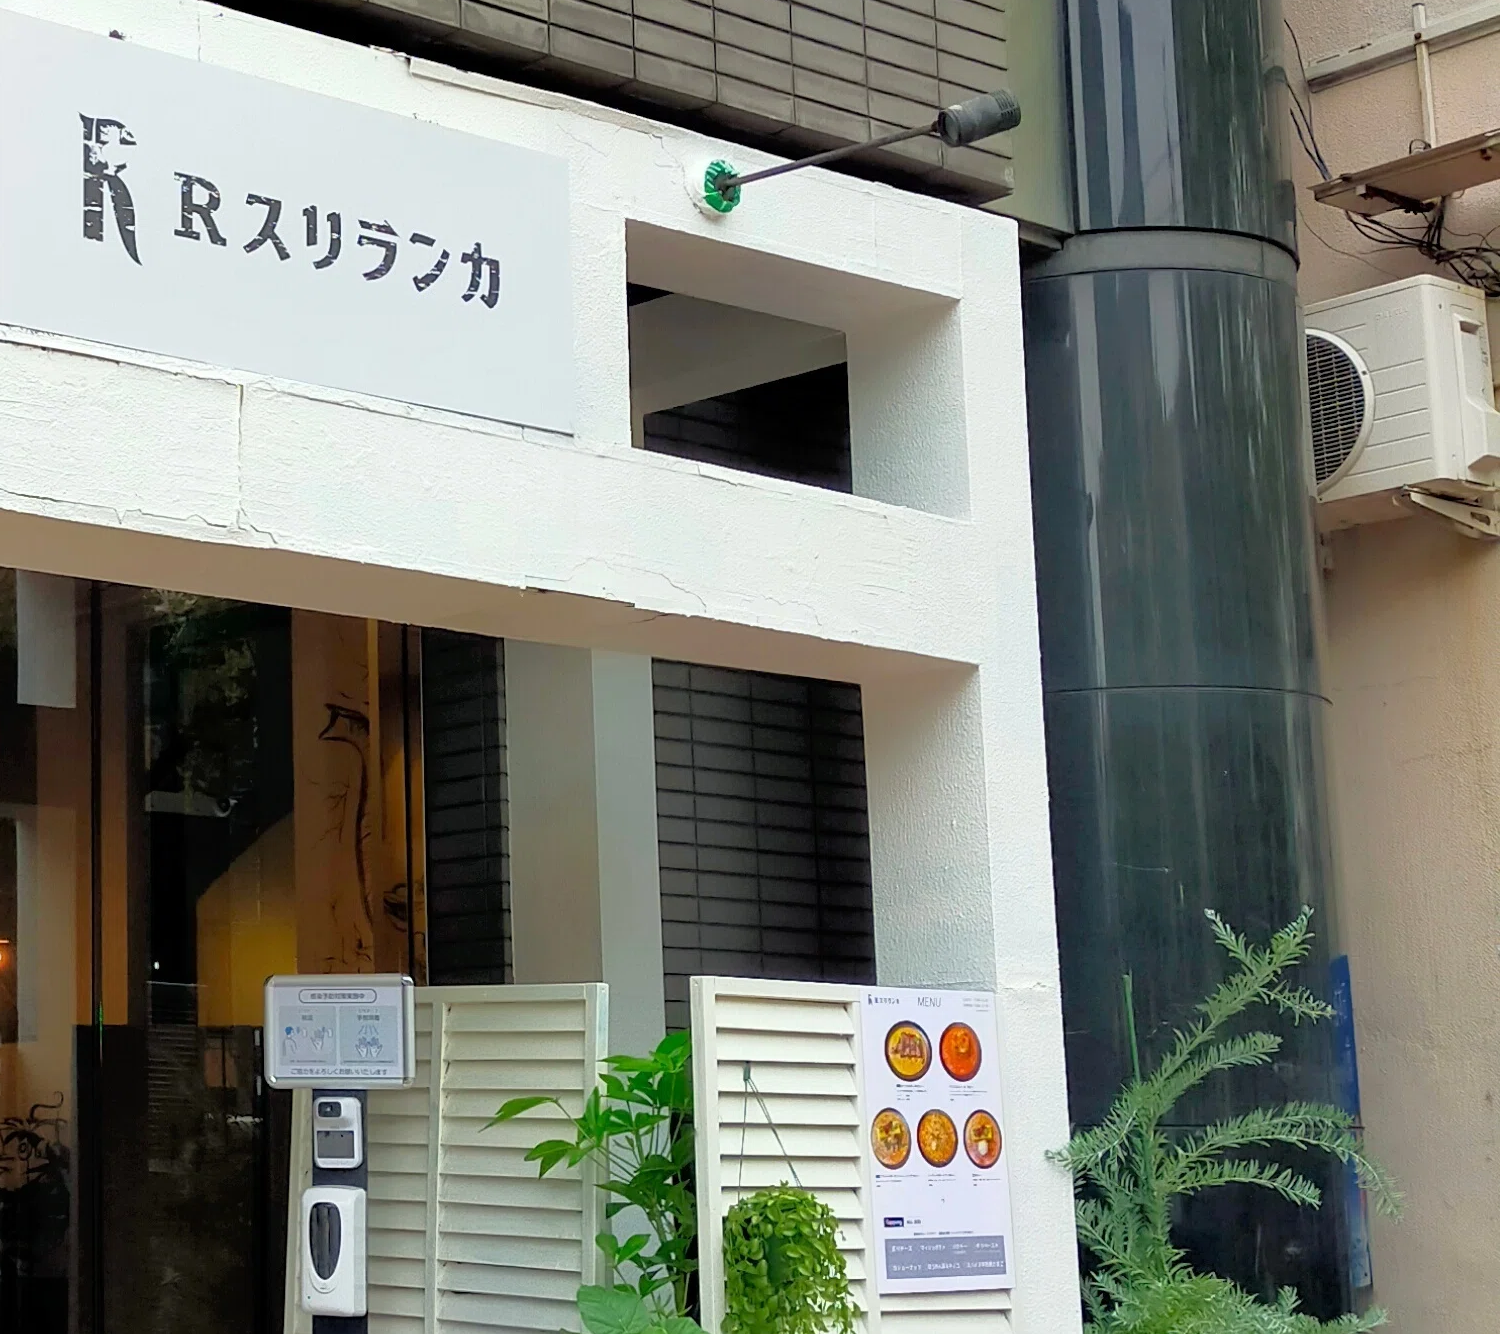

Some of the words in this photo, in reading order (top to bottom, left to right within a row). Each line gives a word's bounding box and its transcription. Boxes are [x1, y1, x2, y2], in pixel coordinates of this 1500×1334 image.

[174, 171, 501, 309] Rスリランカ
[917, 997, 942, 1007] MENU
